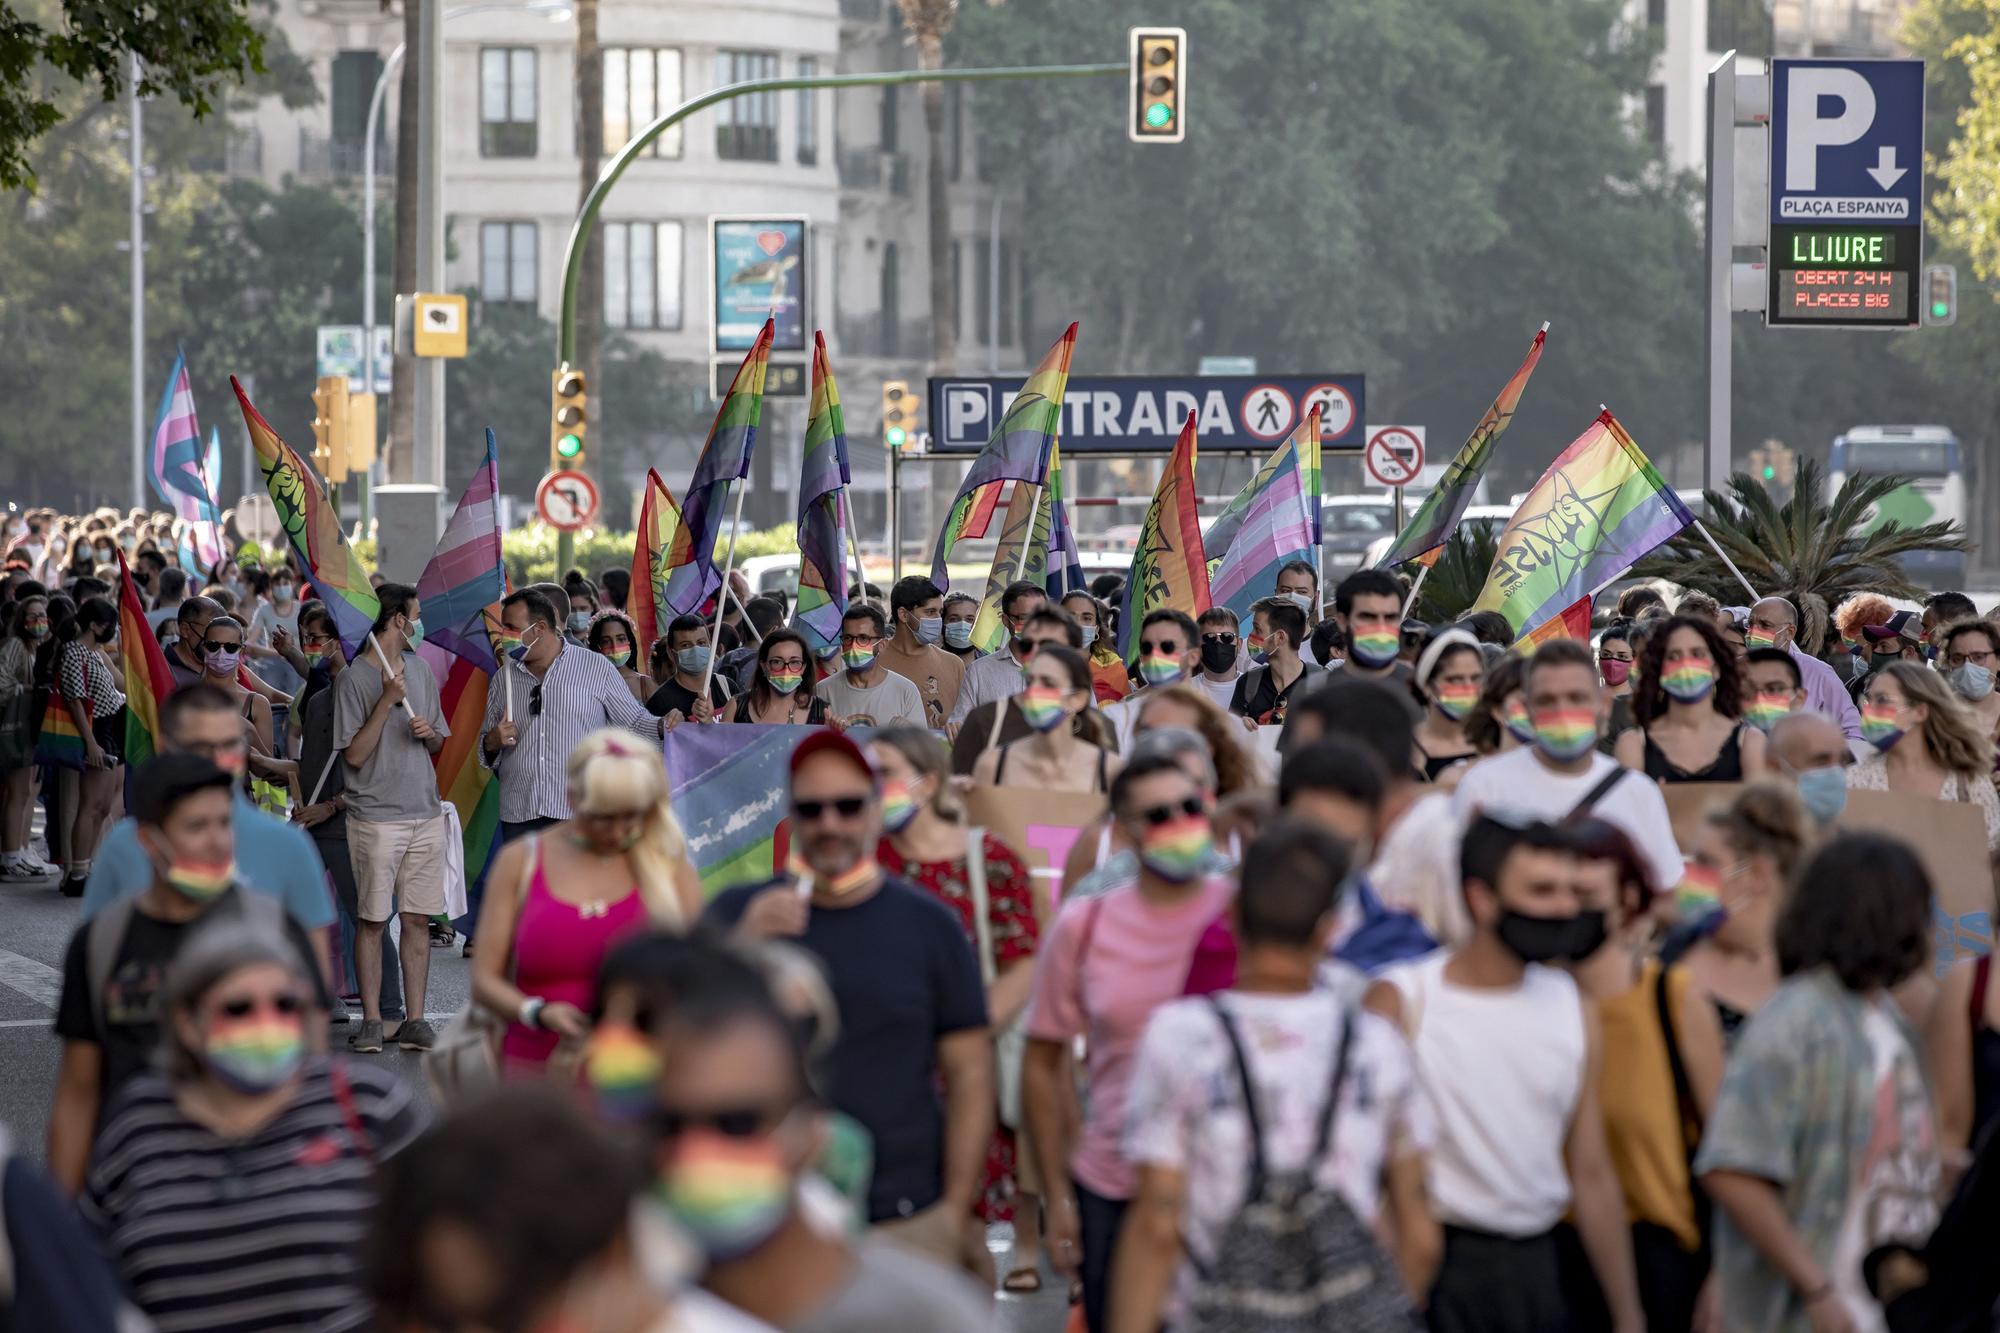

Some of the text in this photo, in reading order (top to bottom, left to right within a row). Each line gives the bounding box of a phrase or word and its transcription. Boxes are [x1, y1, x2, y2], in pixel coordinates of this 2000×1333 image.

[1786, 67, 1876, 191] P
[1783, 201, 1904, 216] PLAÇA ESPANYA
[1793, 235, 1883, 262] LLIURE
[1794, 270, 1892, 285] OBERT 24 H
[1795, 293, 1890, 307] PLACES BIG
[949, 390, 1235, 439] P TRADA
